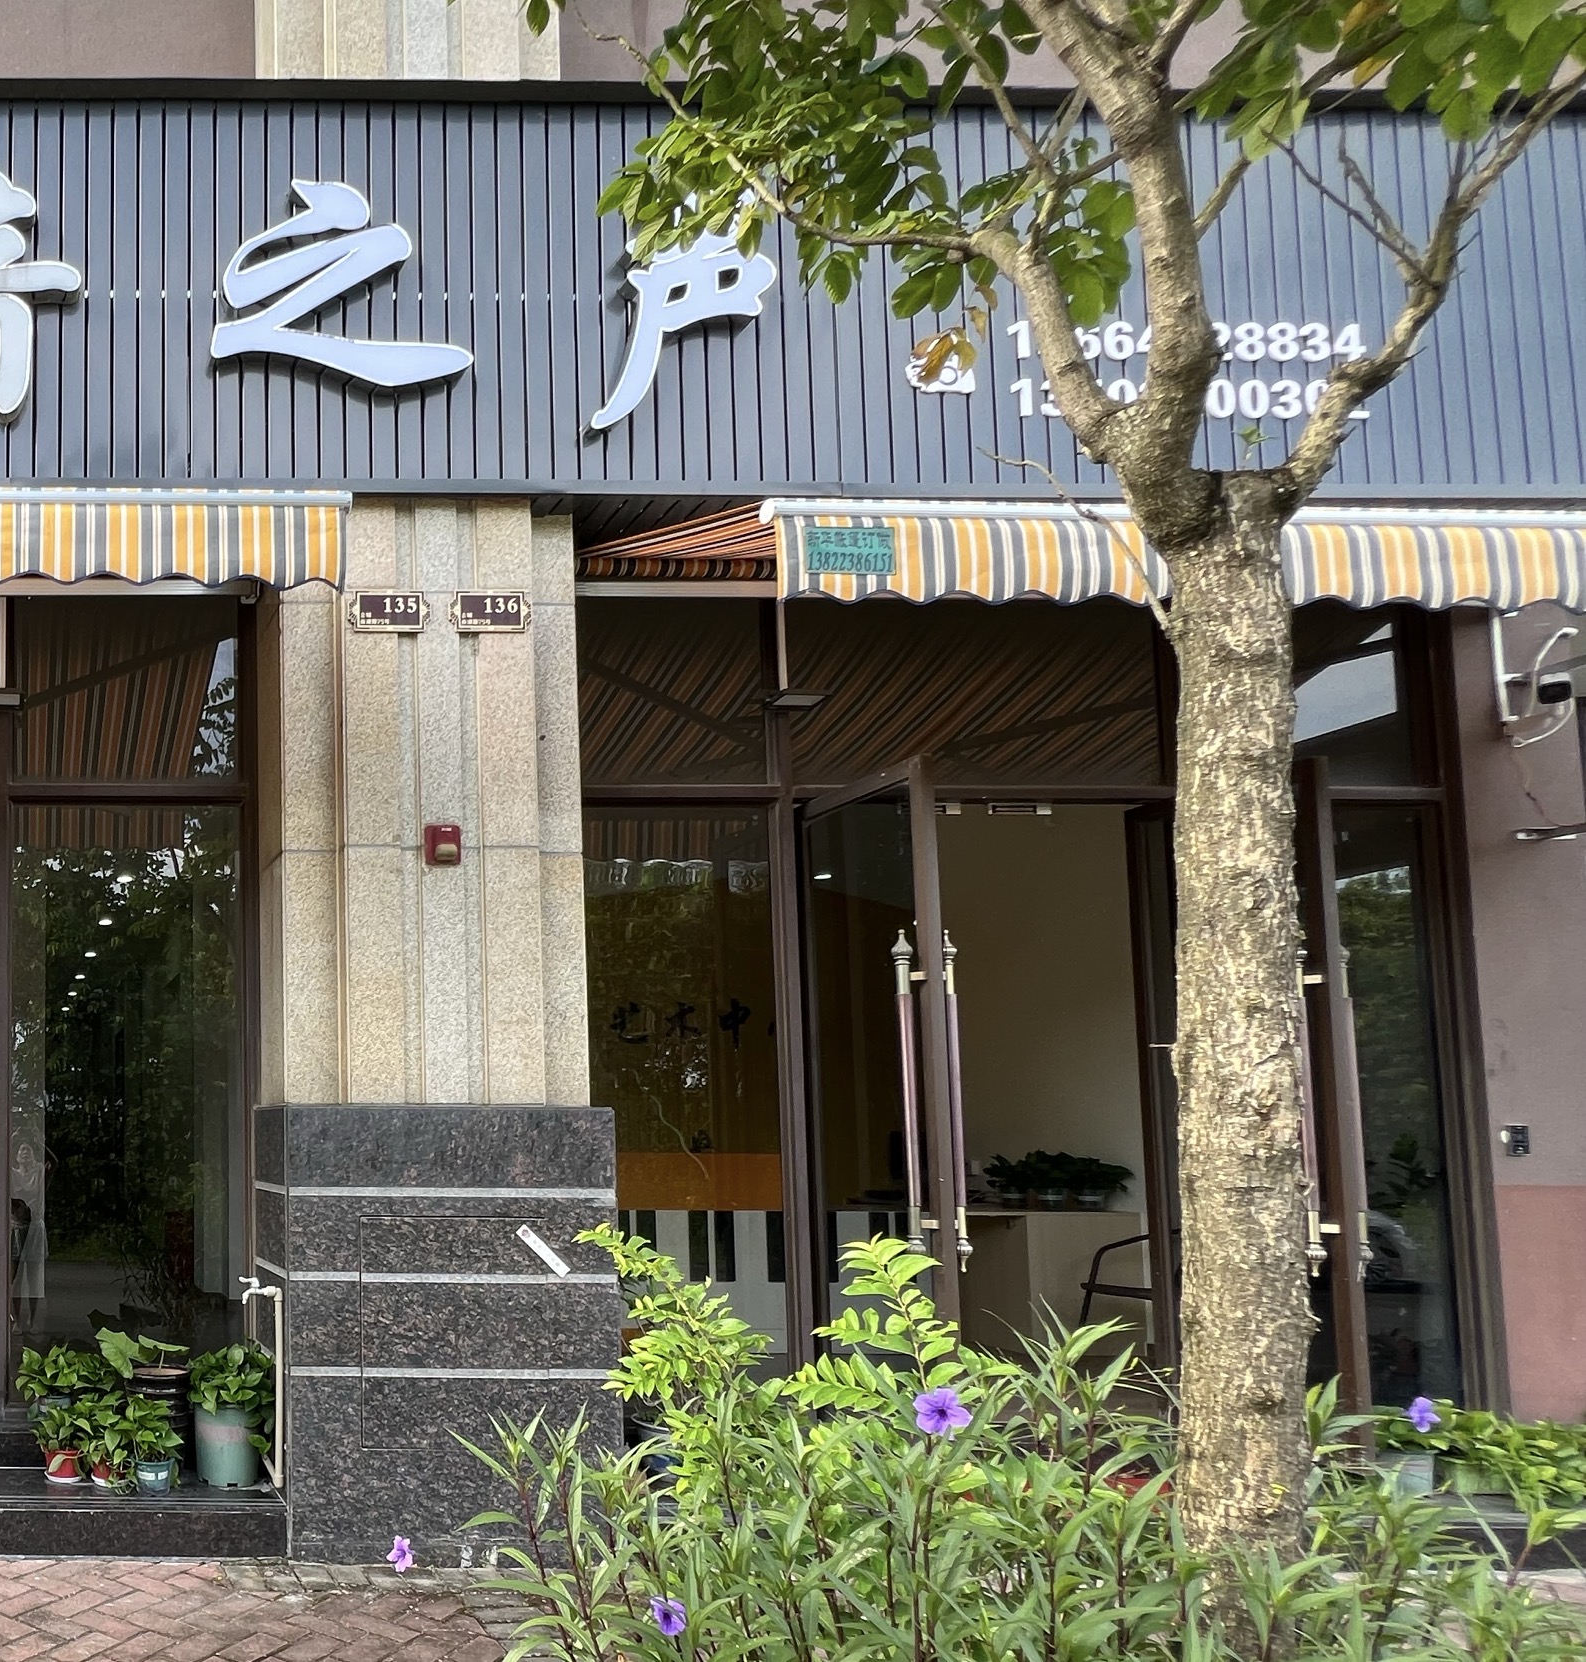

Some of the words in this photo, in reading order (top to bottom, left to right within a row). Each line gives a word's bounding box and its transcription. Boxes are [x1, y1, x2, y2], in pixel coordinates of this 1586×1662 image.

[809, 552, 892, 572] 13822386151
[383, 597, 418, 613] 135
[484, 597, 518, 613] 136
[610, 998, 776, 1050] 艺术中
